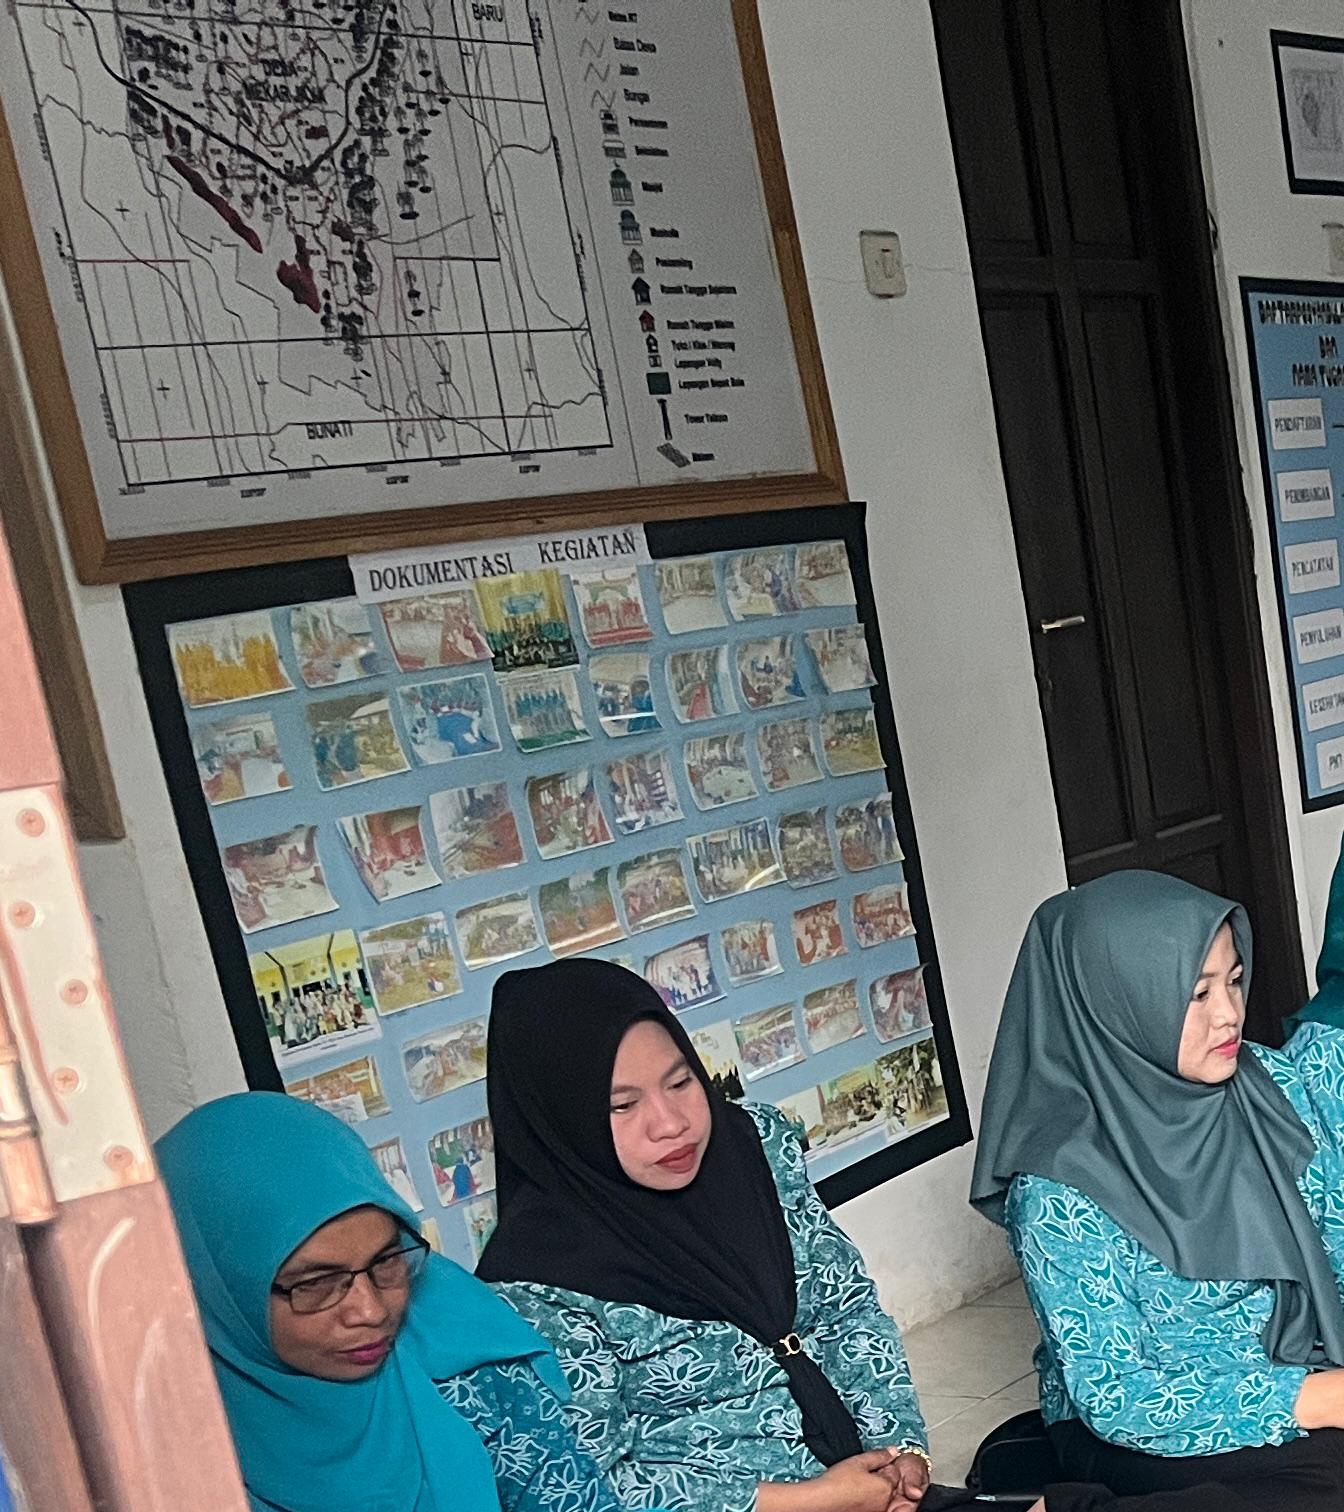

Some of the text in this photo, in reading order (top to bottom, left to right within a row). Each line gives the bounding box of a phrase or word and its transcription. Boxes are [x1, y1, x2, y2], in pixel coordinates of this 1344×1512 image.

[472, 4, 503, 22] BARU
[305, 422, 353, 440] BUNATI
[369, 532, 637, 592] DOKUMENTASI KEGIATAN
